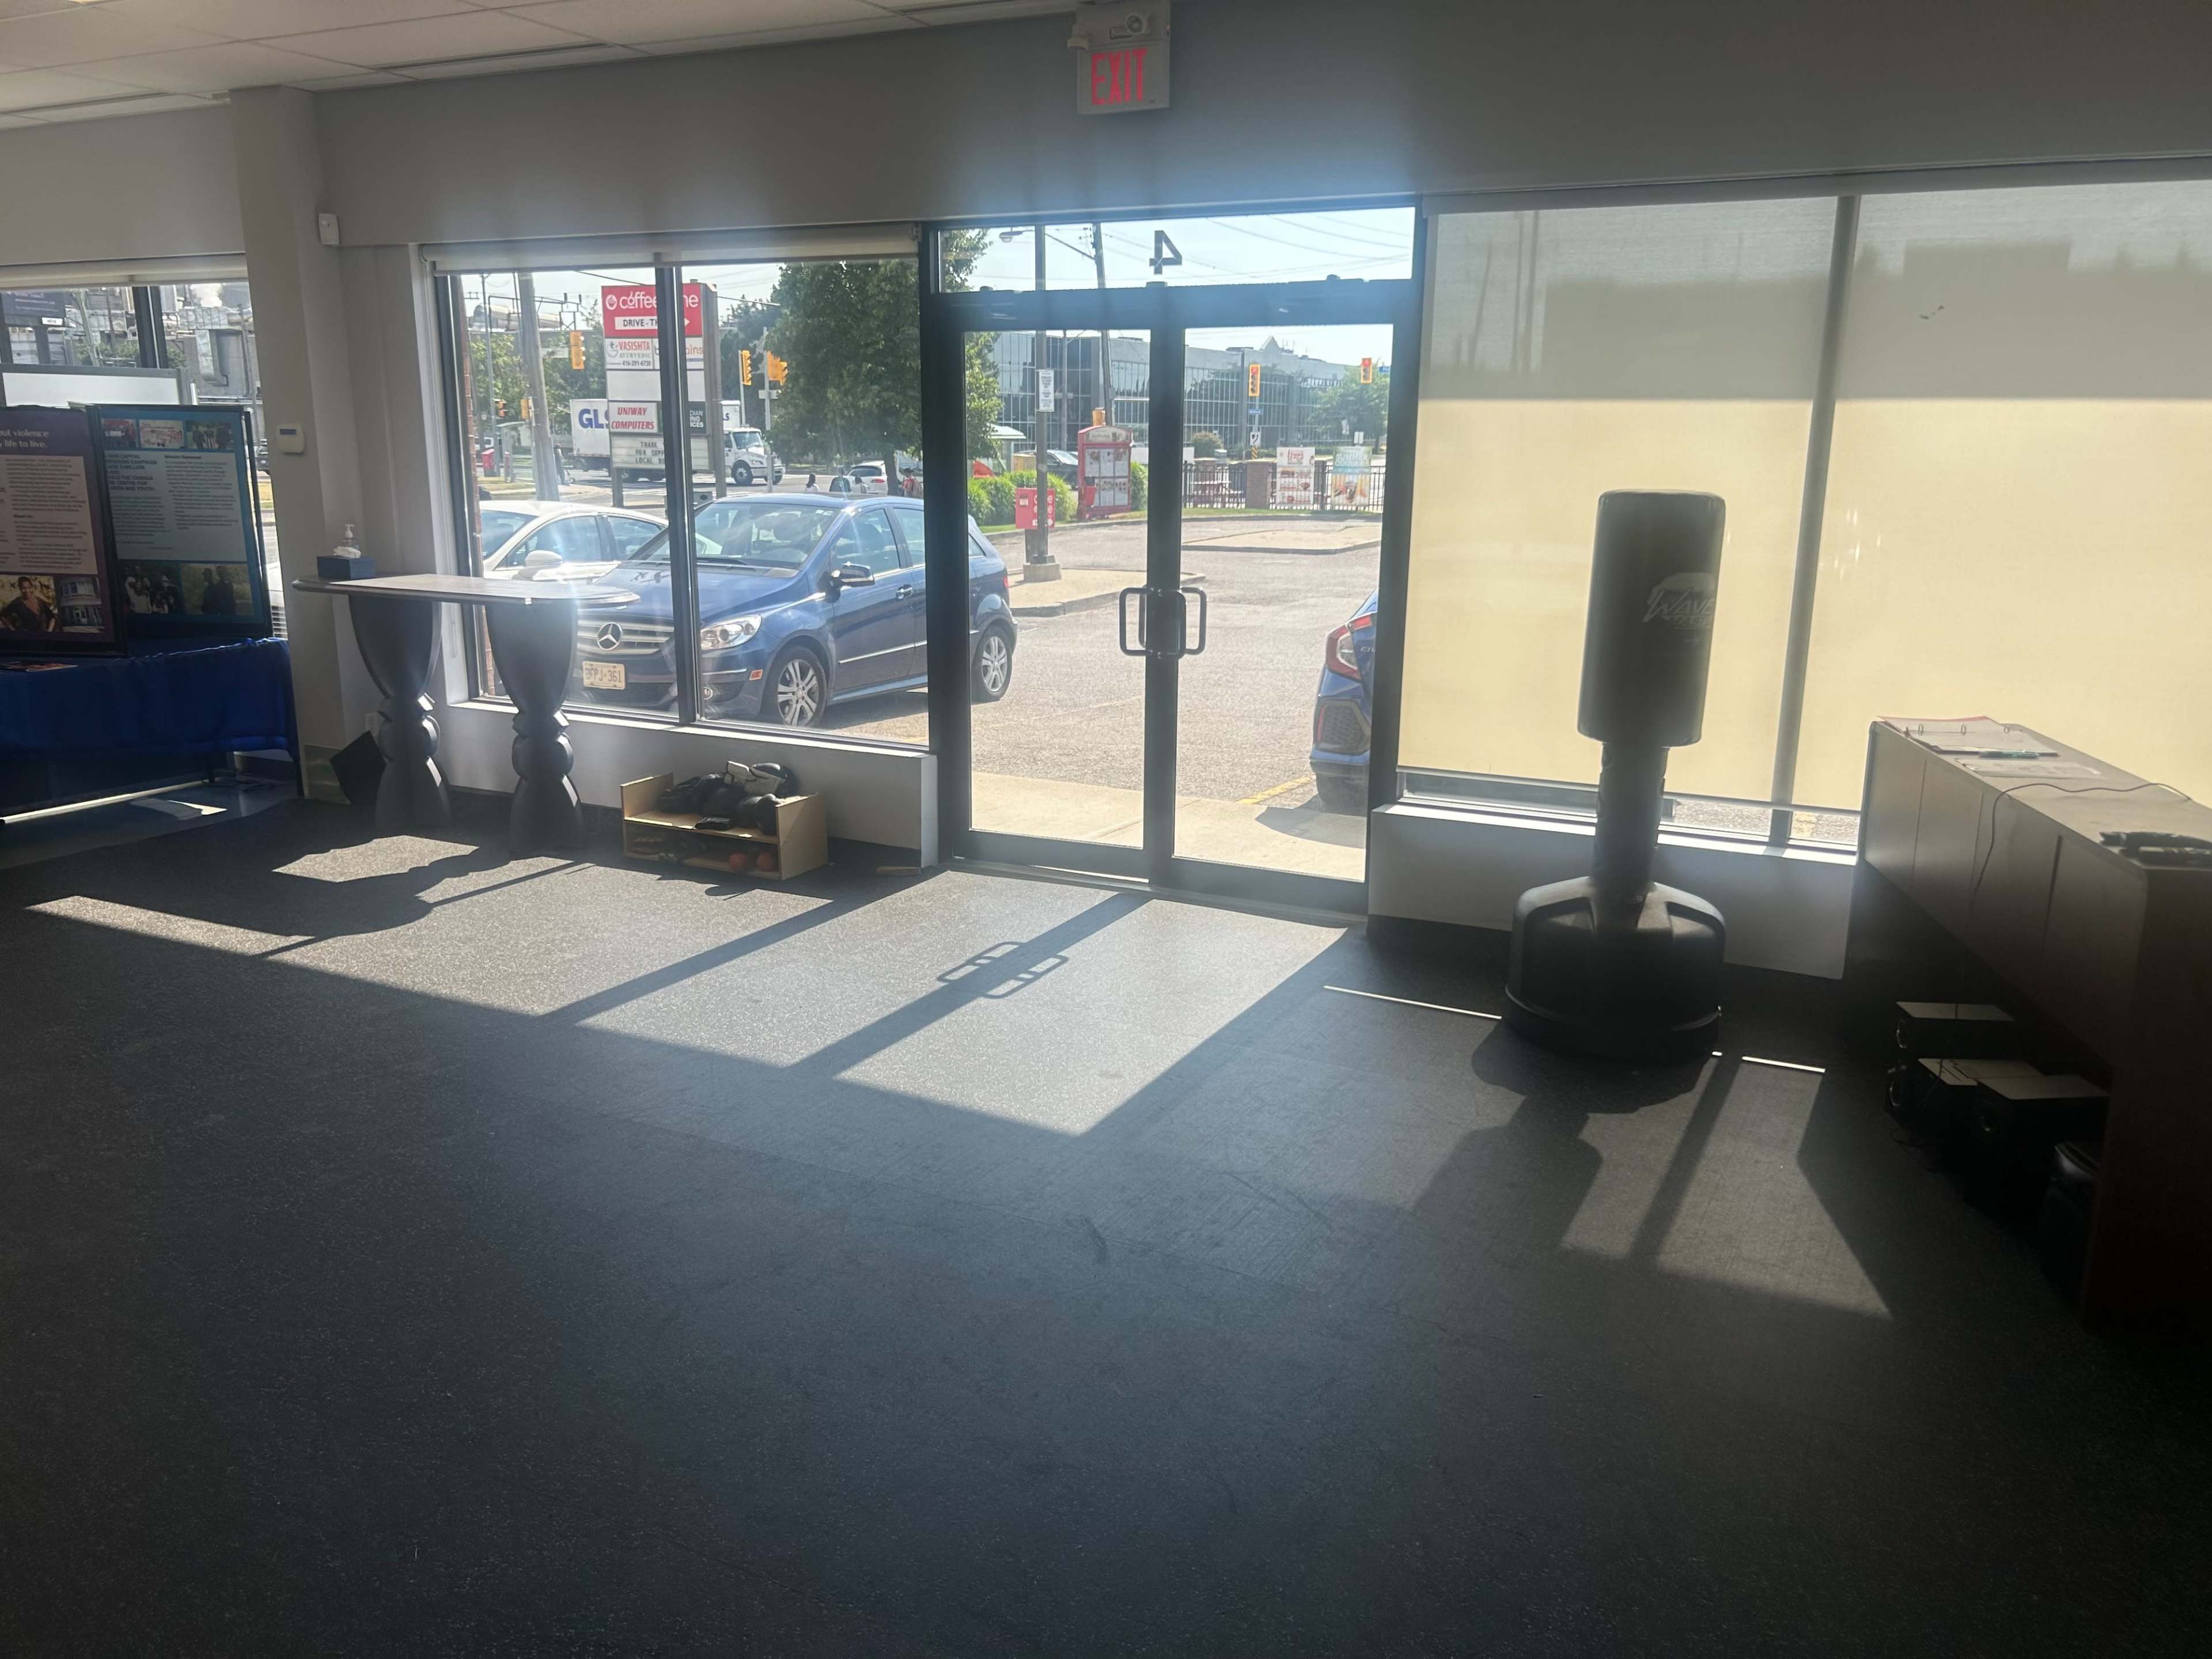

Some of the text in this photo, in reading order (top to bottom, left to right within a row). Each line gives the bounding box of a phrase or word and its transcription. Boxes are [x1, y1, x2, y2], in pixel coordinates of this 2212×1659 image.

[1091, 48, 1147, 106] EXIT
[623, 319, 645, 328] DRIVE
[618, 341, 651, 351] VASISHTA
[617, 407, 648, 416] UNIWAY
[611, 420, 655, 430] COMPUTERS
[13, 429, 50, 438] violence
[4, 439, 18, 448] life
[19, 440, 28, 448] to
